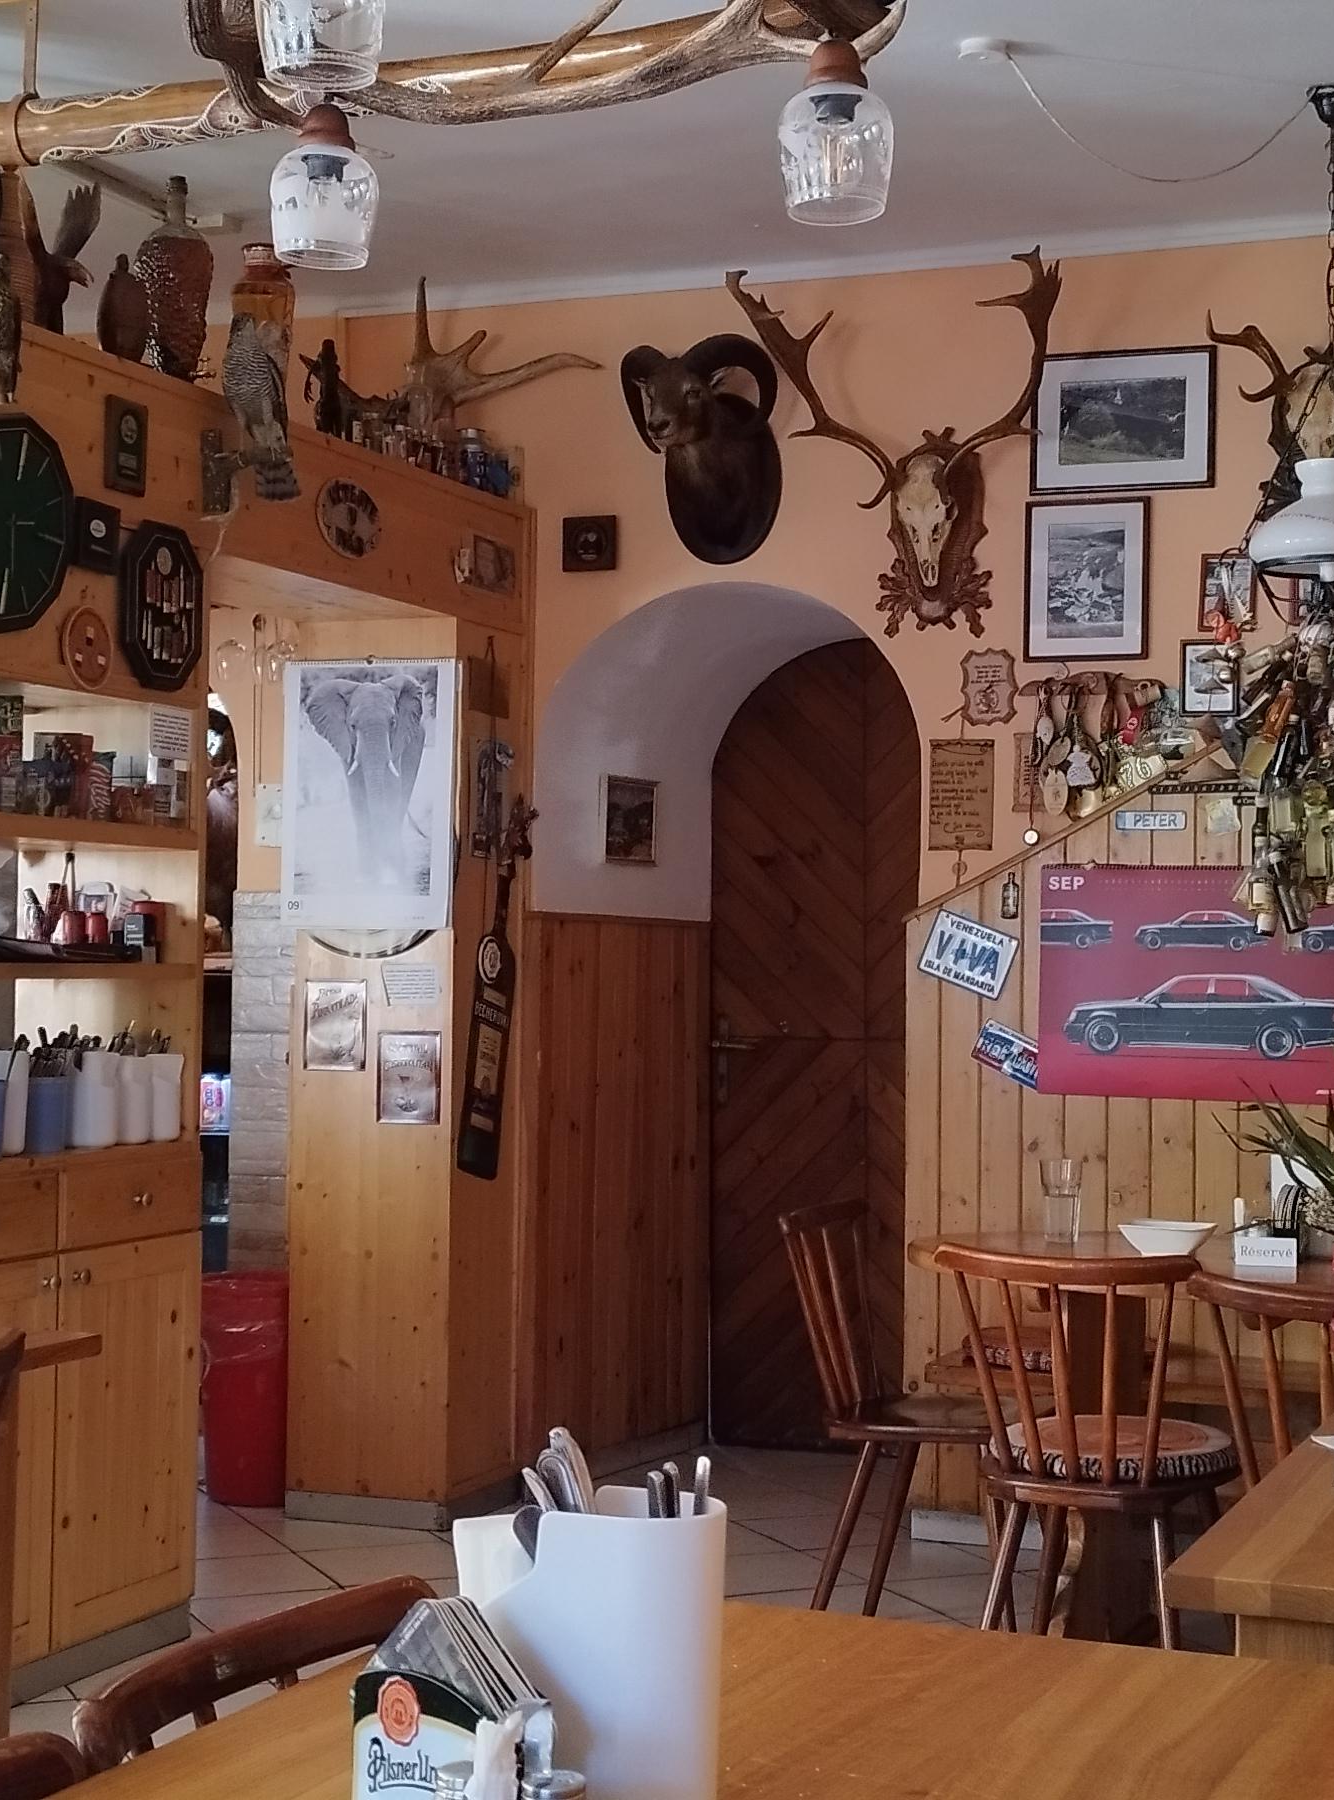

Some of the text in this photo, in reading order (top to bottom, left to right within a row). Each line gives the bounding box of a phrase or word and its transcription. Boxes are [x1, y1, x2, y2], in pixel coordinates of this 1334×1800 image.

[1133, 813, 1178, 827] PETER
[1048, 875, 1085, 891] SEP
[287, 900, 300, 911] 09
[949, 917, 1005, 948] VENEZUELA
[924, 959, 995, 996] ISLA DE MARGARITA
[367, 1736, 418, 1793] Pilsner
